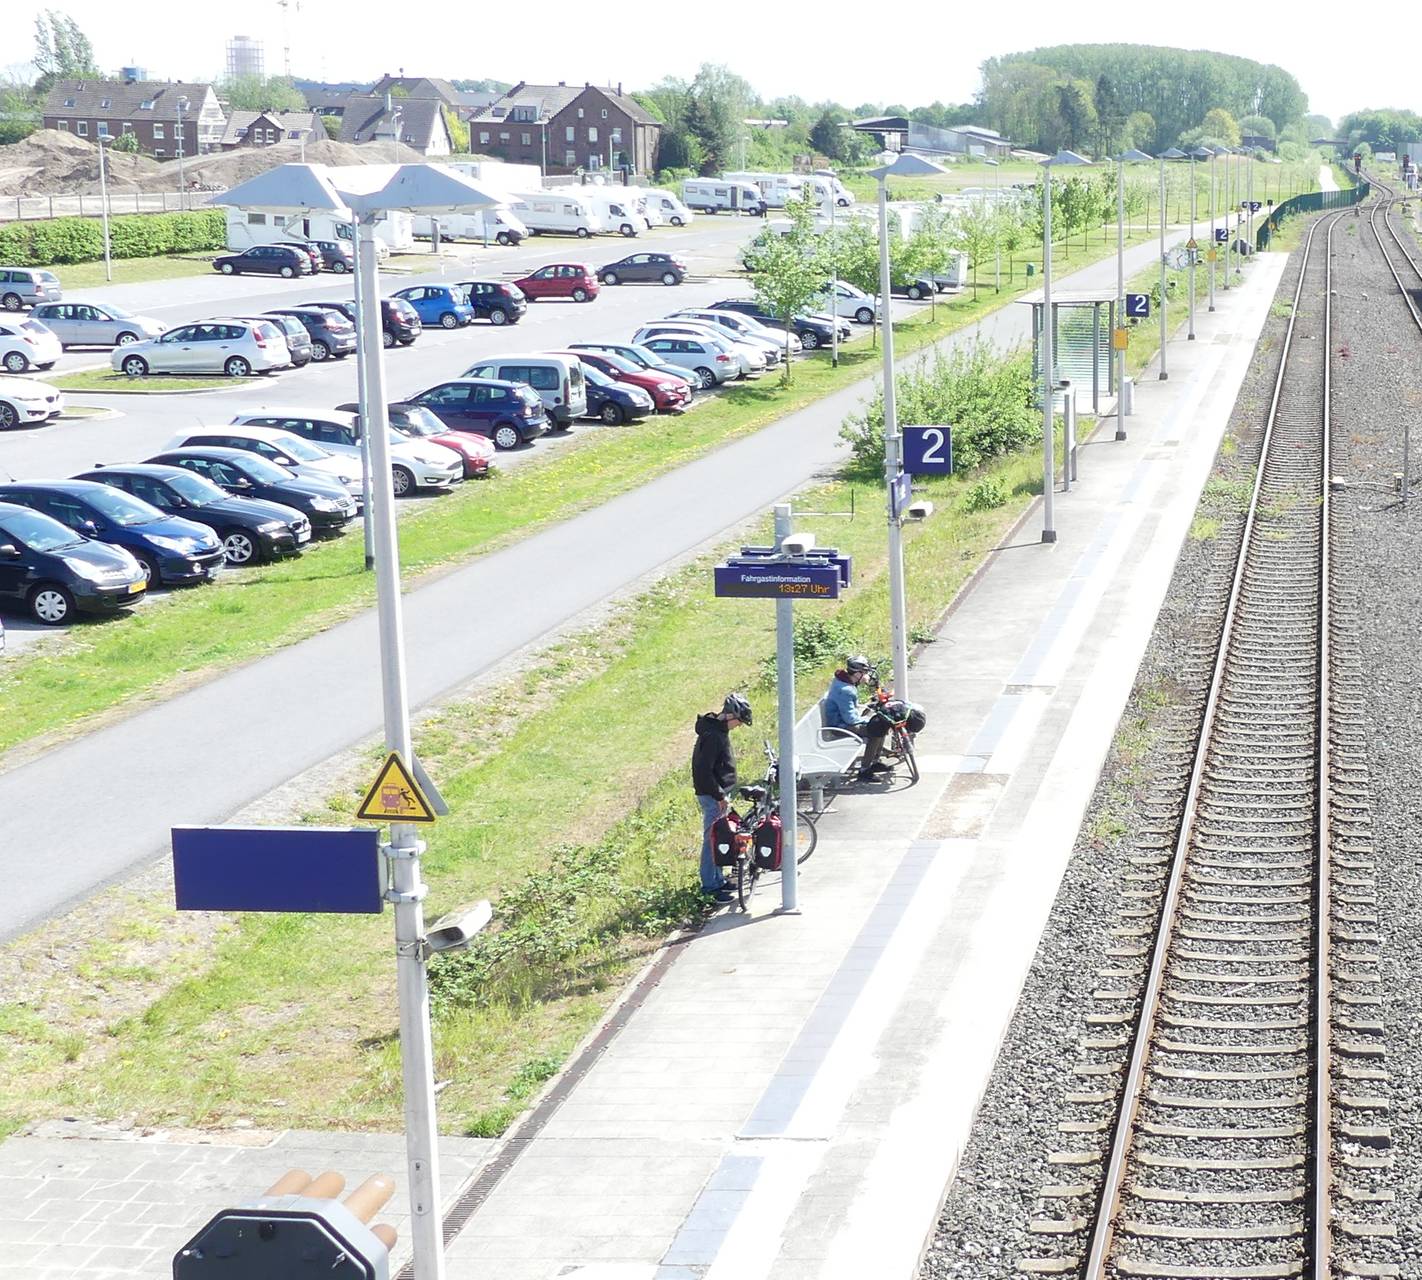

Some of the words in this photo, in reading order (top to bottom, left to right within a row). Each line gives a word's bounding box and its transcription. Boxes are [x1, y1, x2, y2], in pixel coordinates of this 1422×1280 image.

[1220, 229, 1228, 240] 2
[1135, 295, 1147, 312] 2
[921, 428, 945, 463] 2
[741, 574, 811, 583] Fahrgastinformation
[779, 584, 808, 593] 13:27
[810, 584, 830, 594] Uhr
